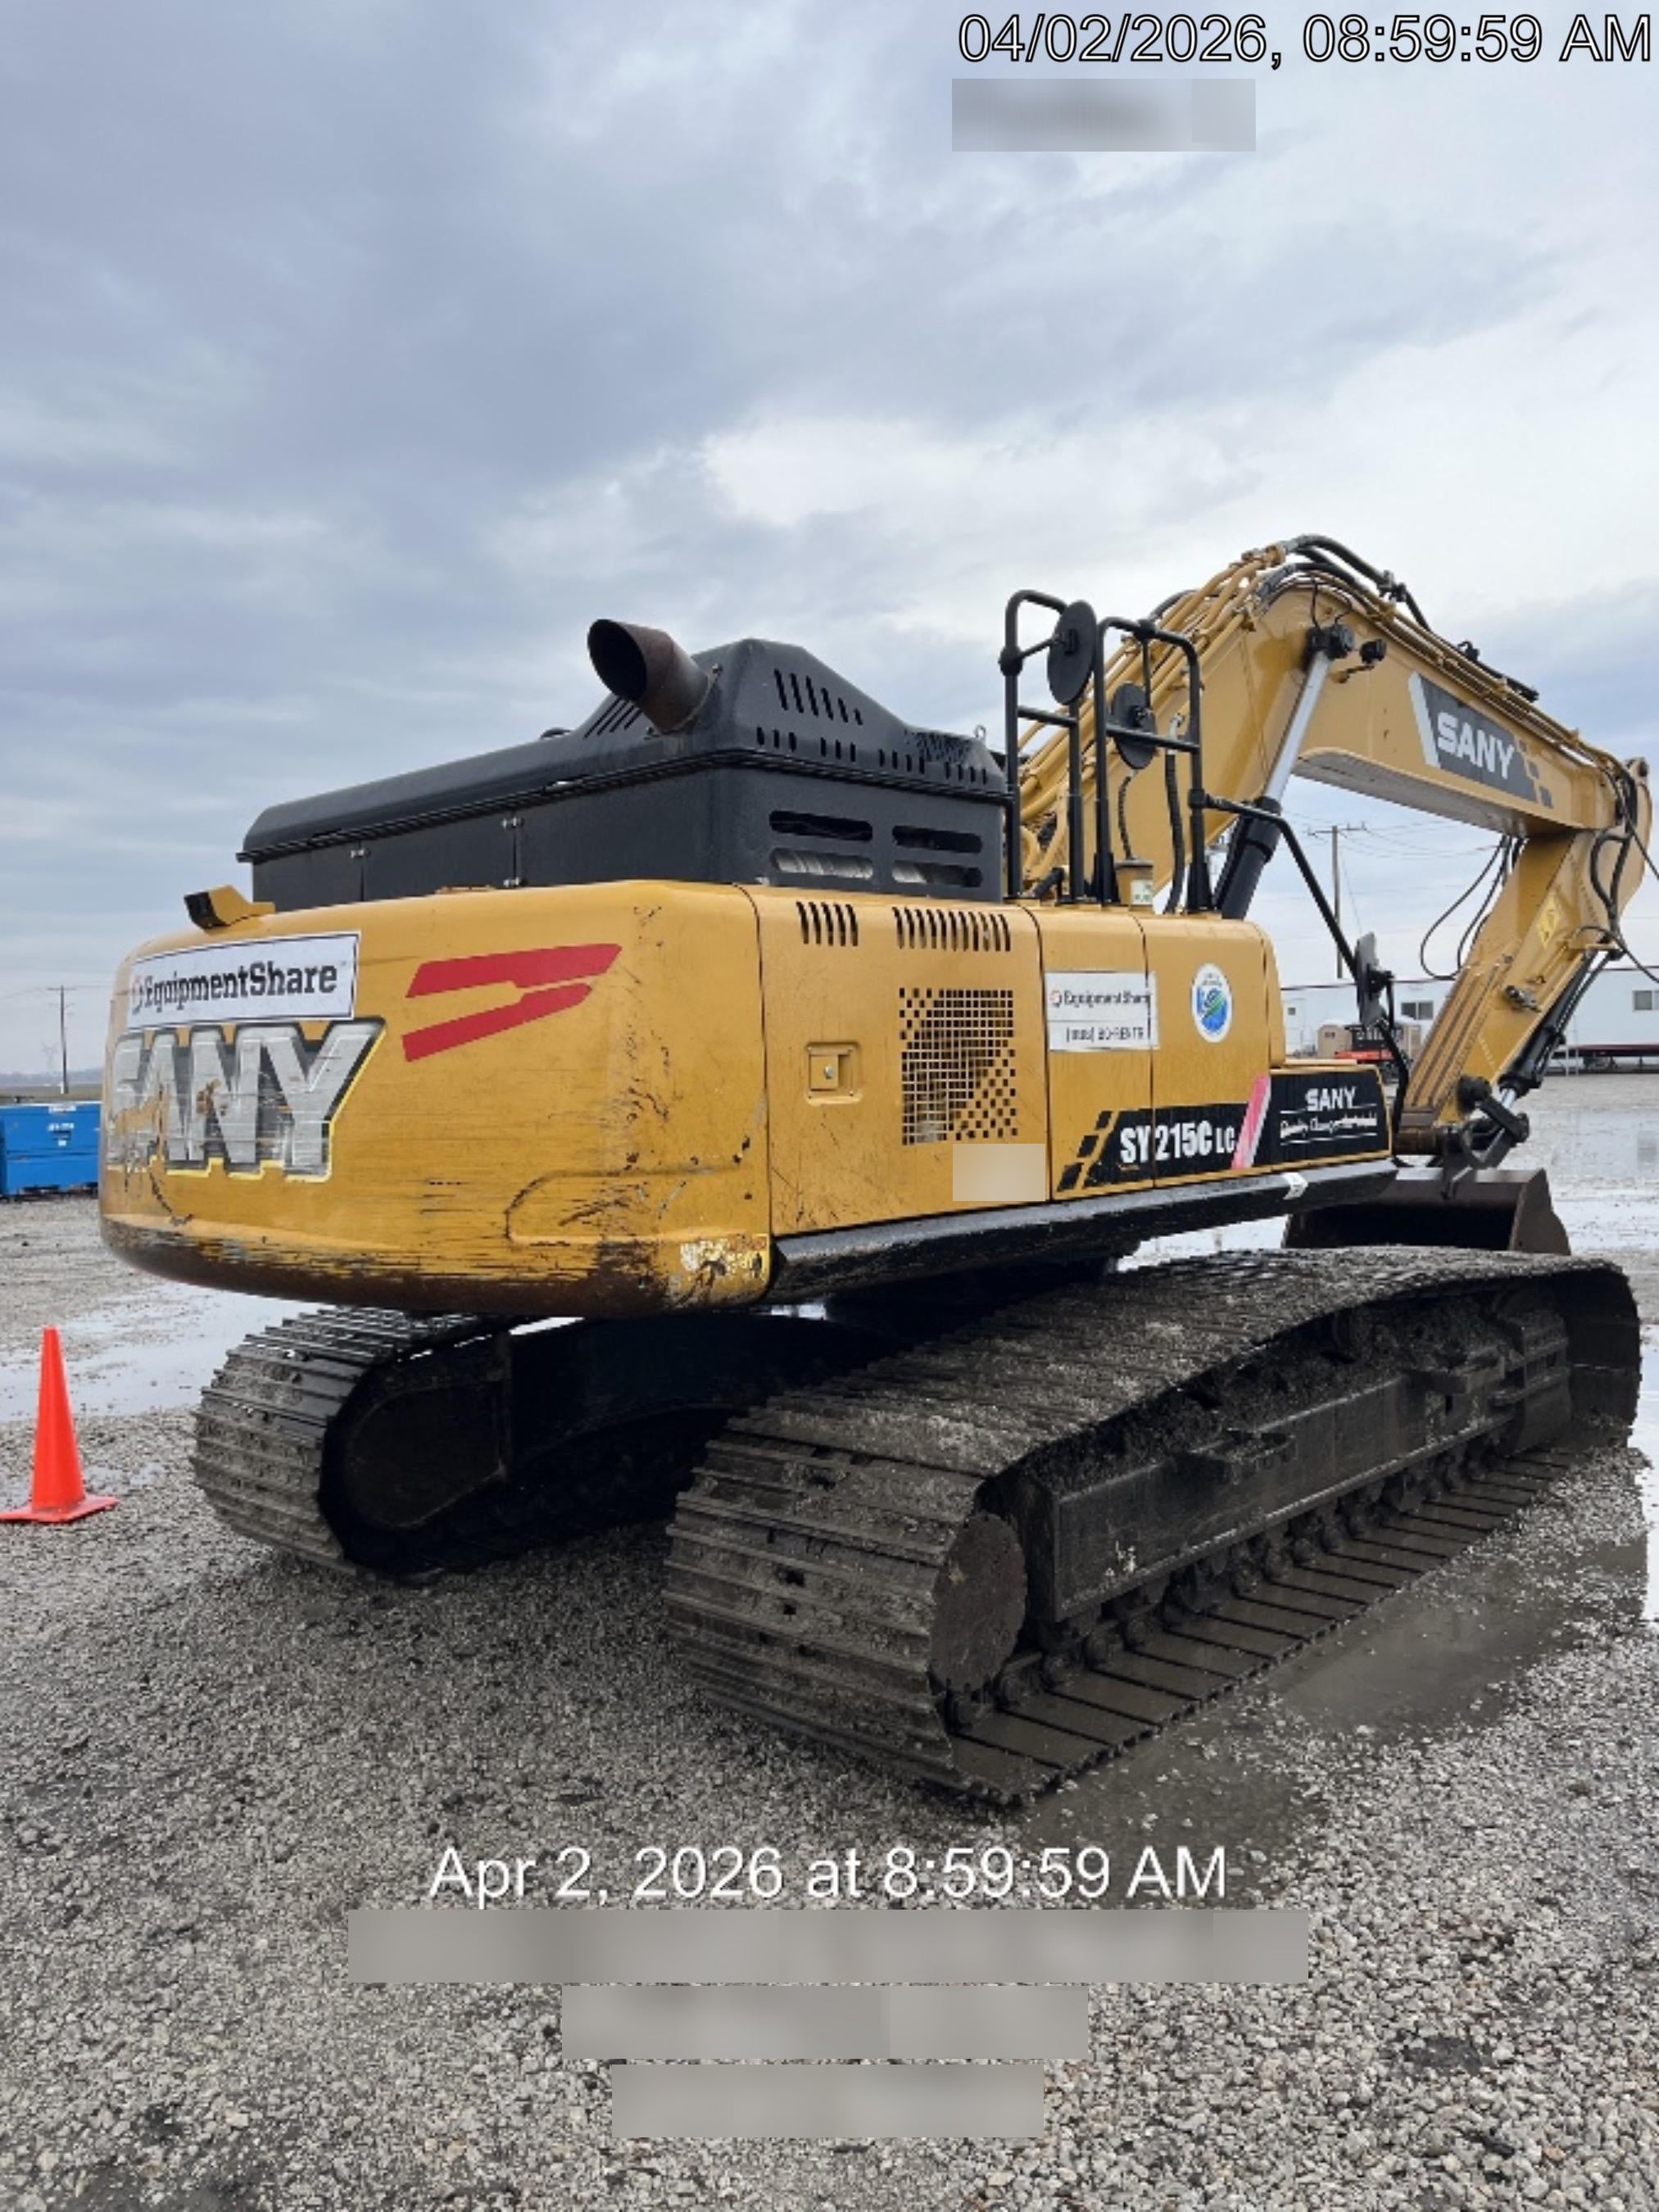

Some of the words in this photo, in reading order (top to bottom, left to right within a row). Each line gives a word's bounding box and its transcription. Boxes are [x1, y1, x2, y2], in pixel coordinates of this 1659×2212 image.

[1437, 712, 1516, 779] SANY
[144, 961, 338, 1013] EquipmentShare
[1304, 1086, 1357, 1112] SANY
